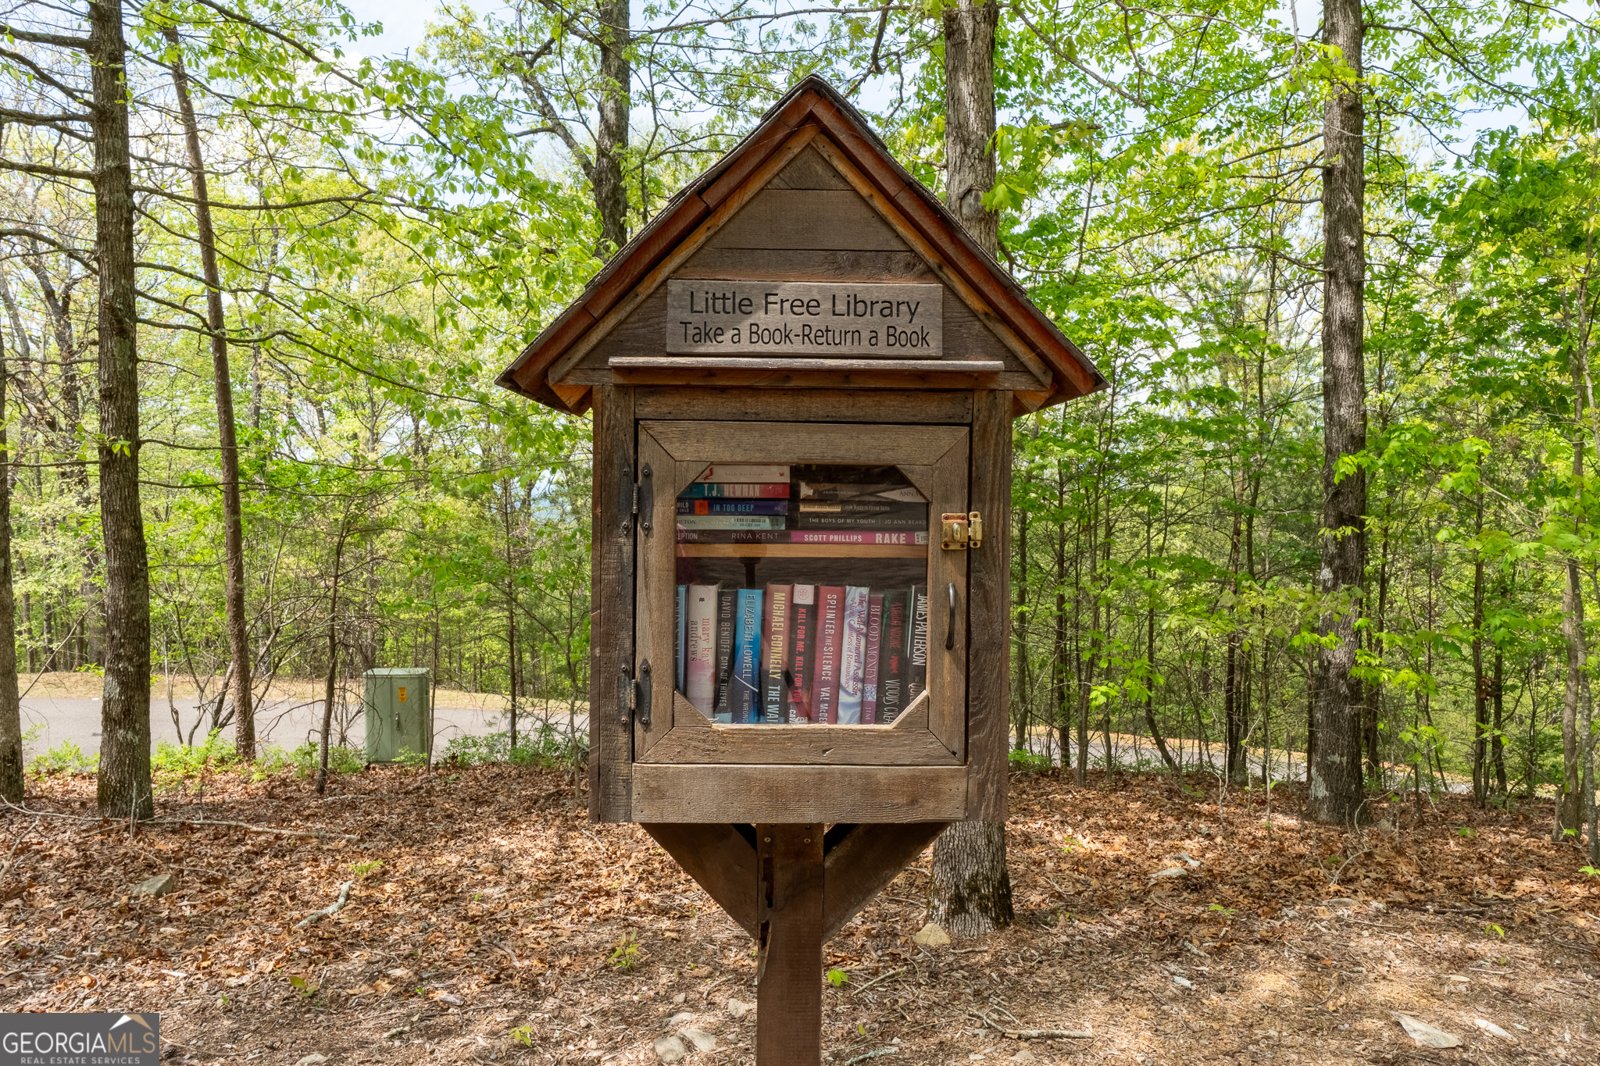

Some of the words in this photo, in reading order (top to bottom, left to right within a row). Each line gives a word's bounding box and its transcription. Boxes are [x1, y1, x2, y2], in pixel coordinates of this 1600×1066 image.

[690, 291, 753, 315] Little
[764, 293, 820, 316] Free
[832, 294, 920, 324] Library
[680, 322, 724, 344] Take
[731, 327, 741, 344] a
[750, 323, 861, 346] Book-Return
[869, 329, 878, 347] a
[886, 325, 930, 348] Book
[724, 484, 760, 497] NEWMAN
[713, 504, 720, 512] IN
[723, 504, 735, 512] TOO
[738, 504, 754, 512] DEEP
[756, 532, 779, 540] KENT
[804, 534, 828, 542] SCOTT
[876, 533, 906, 544] RAKE
[722, 596, 731, 618] DAVID
[744, 594, 756, 642] ELIZABETH
[772, 592, 786, 632] MICHAEL
[798, 608, 806, 623] KILL
[824, 594, 837, 634] SPLINTER
[916, 594, 928, 620] JAMES
[699, 618, 710, 644] mary
[796, 625, 805, 638] FOR
[868, 604, 881, 640] BLOOD
[690, 620, 702, 662] andrews
[720, 622, 730, 653] BENIOFF
[824, 635, 832, 646] THE
[912, 621, 926, 666] PATTERSON
[699, 647, 712, 664] kay
[720, 656, 728, 669] CITY
[742, 644, 754, 678] LOWELL
[768, 634, 783, 680] CONNELLY
[795, 656, 804, 671] KILL
[821, 646, 834, 681] SILENCE
[866, 646, 879, 681] MONEY
[720, 672, 727, 680] OF
[794, 674, 803, 687] FOR
[719, 682, 727, 707] THIEVES
[742, 690, 750, 702] THE
[768, 686, 780, 702] THE
[820, 686, 830, 700] VAL
[883, 679, 900, 704] VICIOUS
